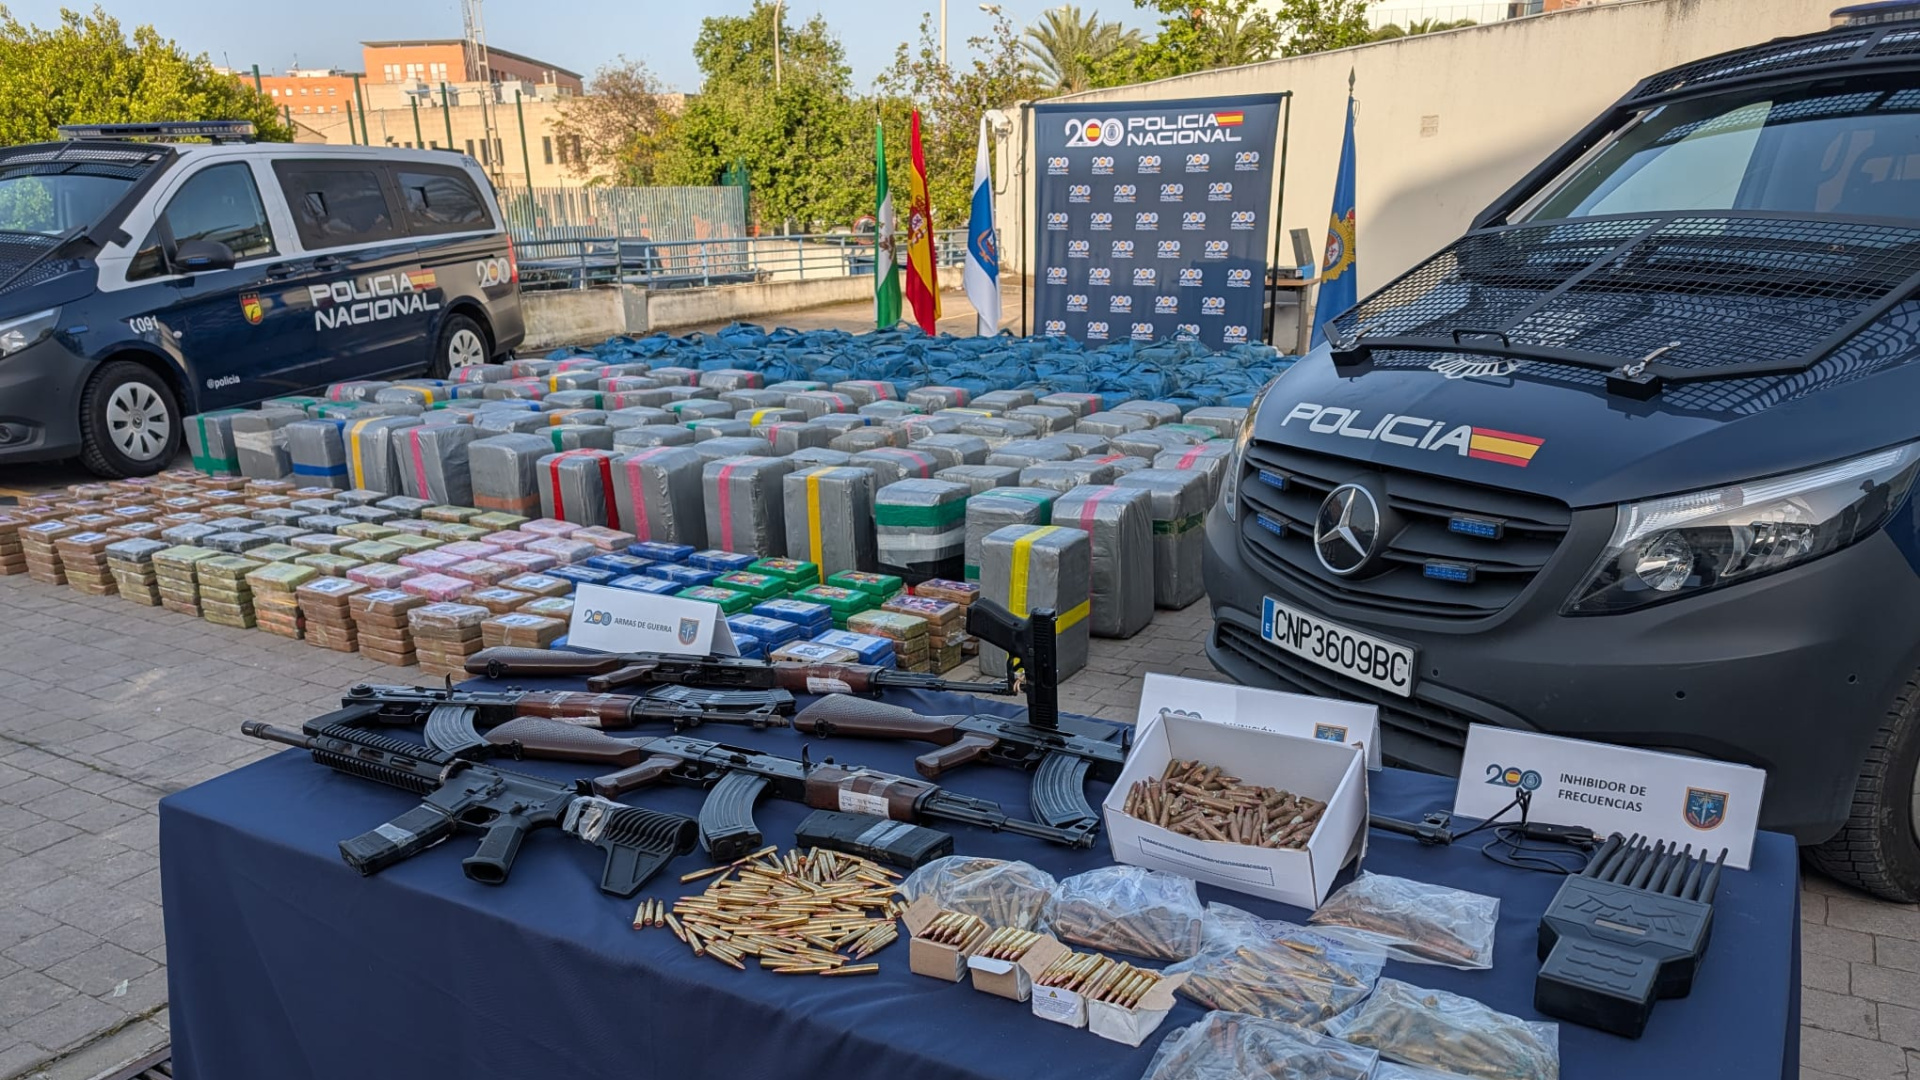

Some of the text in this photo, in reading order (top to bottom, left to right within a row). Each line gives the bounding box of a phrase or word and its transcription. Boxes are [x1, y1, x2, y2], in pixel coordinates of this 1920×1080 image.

[1065, 118, 1124, 147] 200
[1127, 128, 1242, 147] NACIONAL
[1048, 156, 1069, 169] 200
[1092, 156, 1114, 168] 200
[1138, 155, 1161, 167] 200
[1186, 153, 1210, 165] 200
[1235, 151, 1259, 164] 200
[1069, 184, 1091, 196] 200
[1114, 184, 1136, 196] 200
[1160, 183, 1184, 196] 200
[1208, 182, 1233, 194] 200
[1047, 212, 1069, 224] 200
[1090, 212, 1113, 224] 200
[1136, 212, 1159, 224] 200
[1182, 211, 1206, 224] 200
[1231, 210, 1256, 223] 200
[1068, 240, 1090, 252] 200
[1112, 240, 1134, 252] 200
[1158, 240, 1181, 252] 200
[1205, 240, 1229, 252] 200
[476, 257, 511, 288] 200
[1047, 267, 1067, 279] 200
[1089, 267, 1111, 280] 200
[1133, 267, 1156, 280] 200
[1180, 268, 1203, 280] 200
[1228, 268, 1251, 281] 200
[1067, 294, 1088, 306] 200
[1110, 295, 1132, 307] 200
[1155, 295, 1178, 307] 200
[1202, 296, 1225, 309] 200
[314, 292, 440, 331] NACIONAL
[1045, 320, 1066, 332] 200
[1087, 321, 1109, 333] 200
[1131, 322, 1154, 335] 200
[1224, 325, 1248, 337] 200
[584, 609, 672, 633] 200 ARMAS DE GUERRA
[1274, 609, 1408, 687] CNP3609BC
[1484, 763, 1648, 797] 200 INHIBIDOR DE
[1558, 789, 1643, 812] FRECUENCIAS
